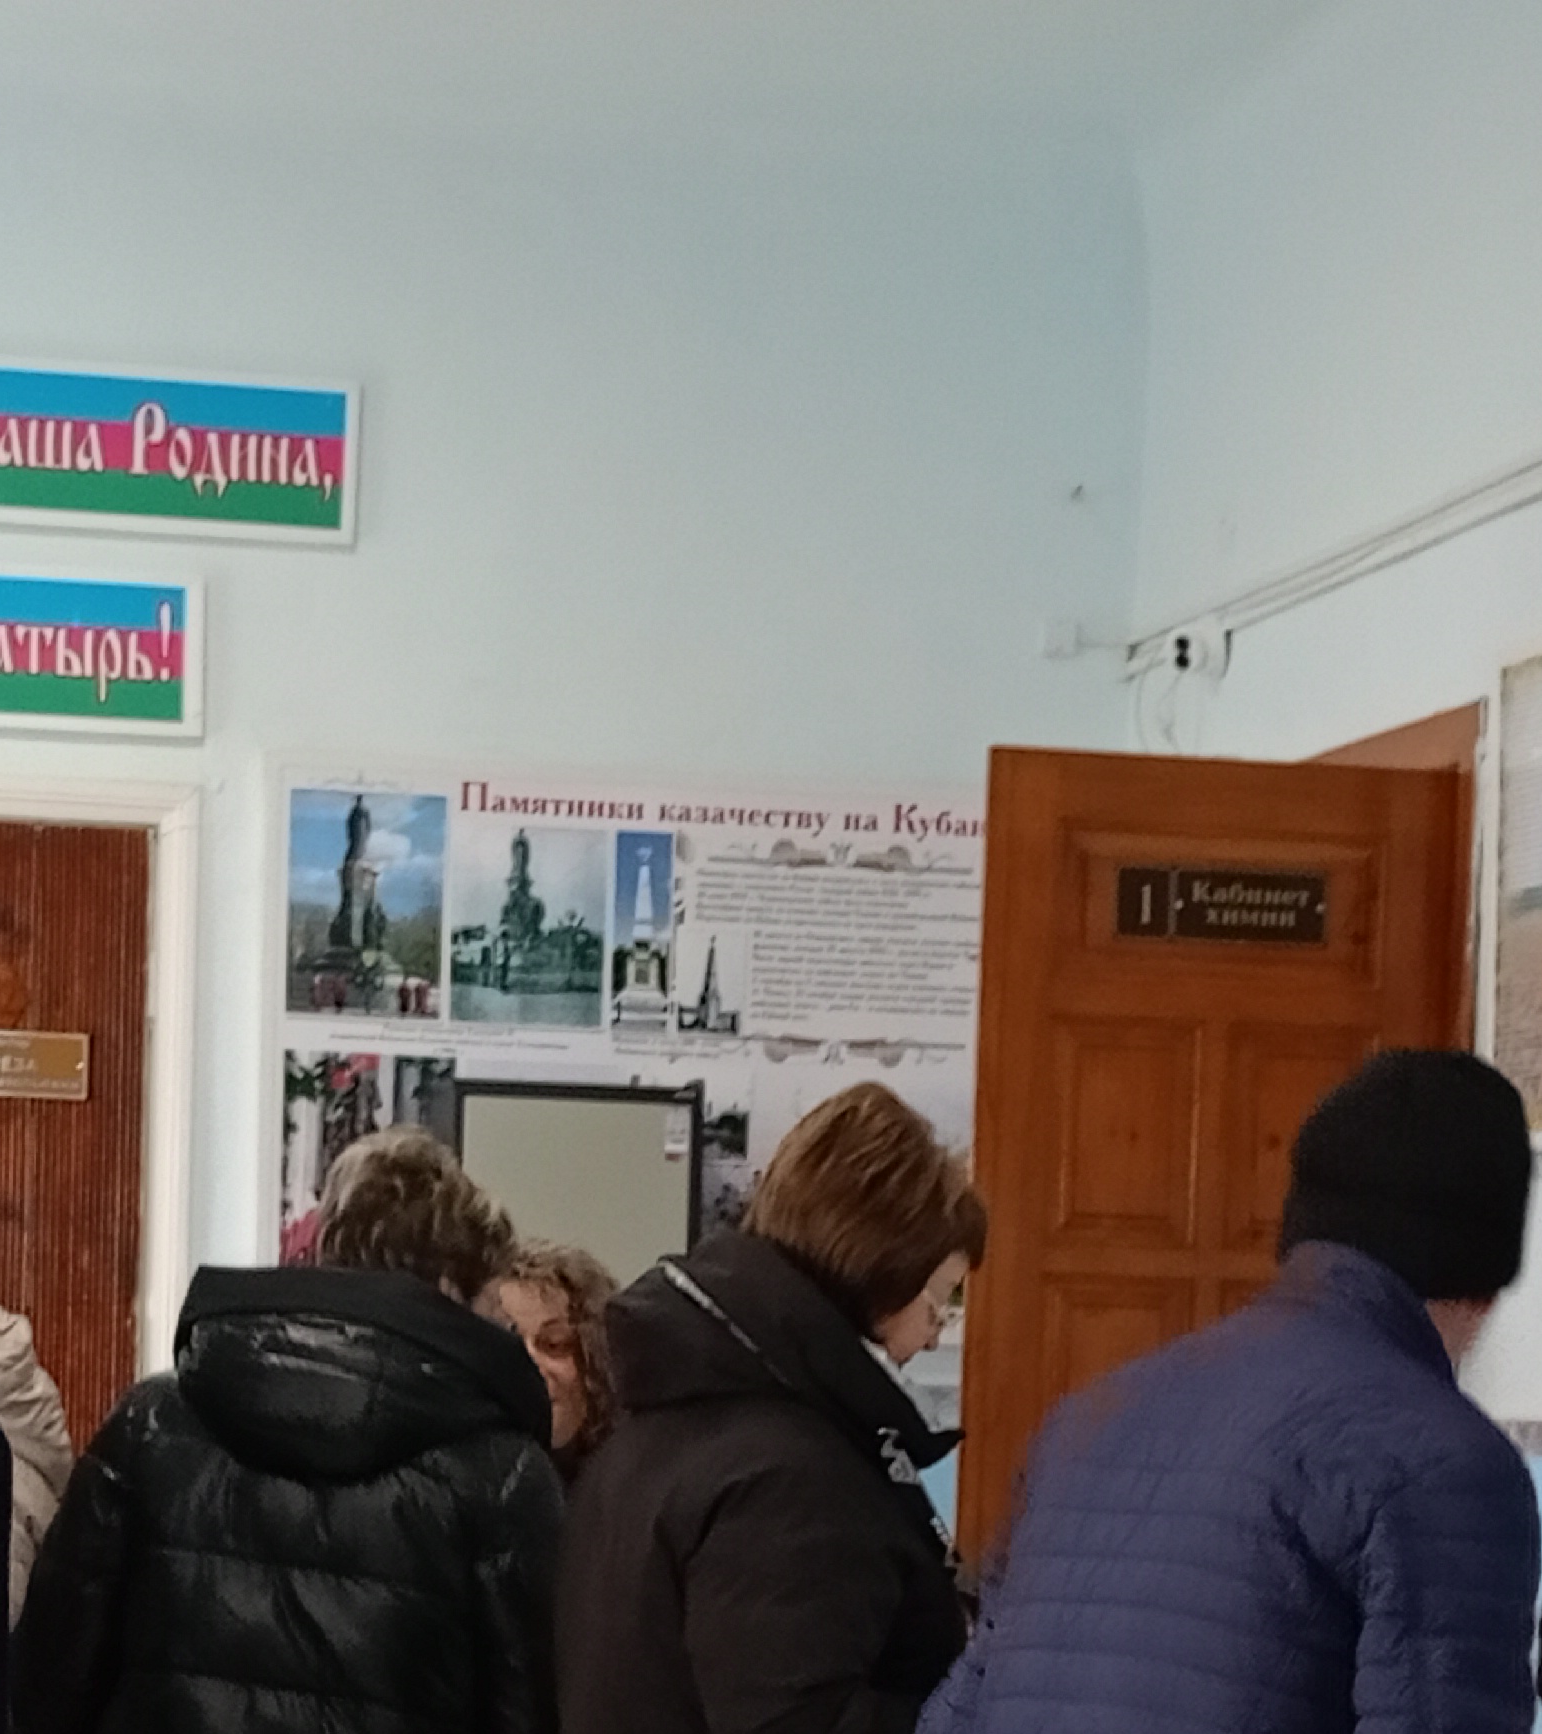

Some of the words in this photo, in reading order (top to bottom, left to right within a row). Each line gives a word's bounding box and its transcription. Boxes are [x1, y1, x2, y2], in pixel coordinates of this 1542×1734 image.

[129, 401, 334, 501] Родина,
[459, 780, 646, 823] Памятники
[659, 798, 829, 836] казачеству
[843, 809, 879, 833] на
[893, 803, 987, 840] Кубан
[1192, 880, 1309, 907] Кабинет
[1206, 909, 1296, 927] химии
